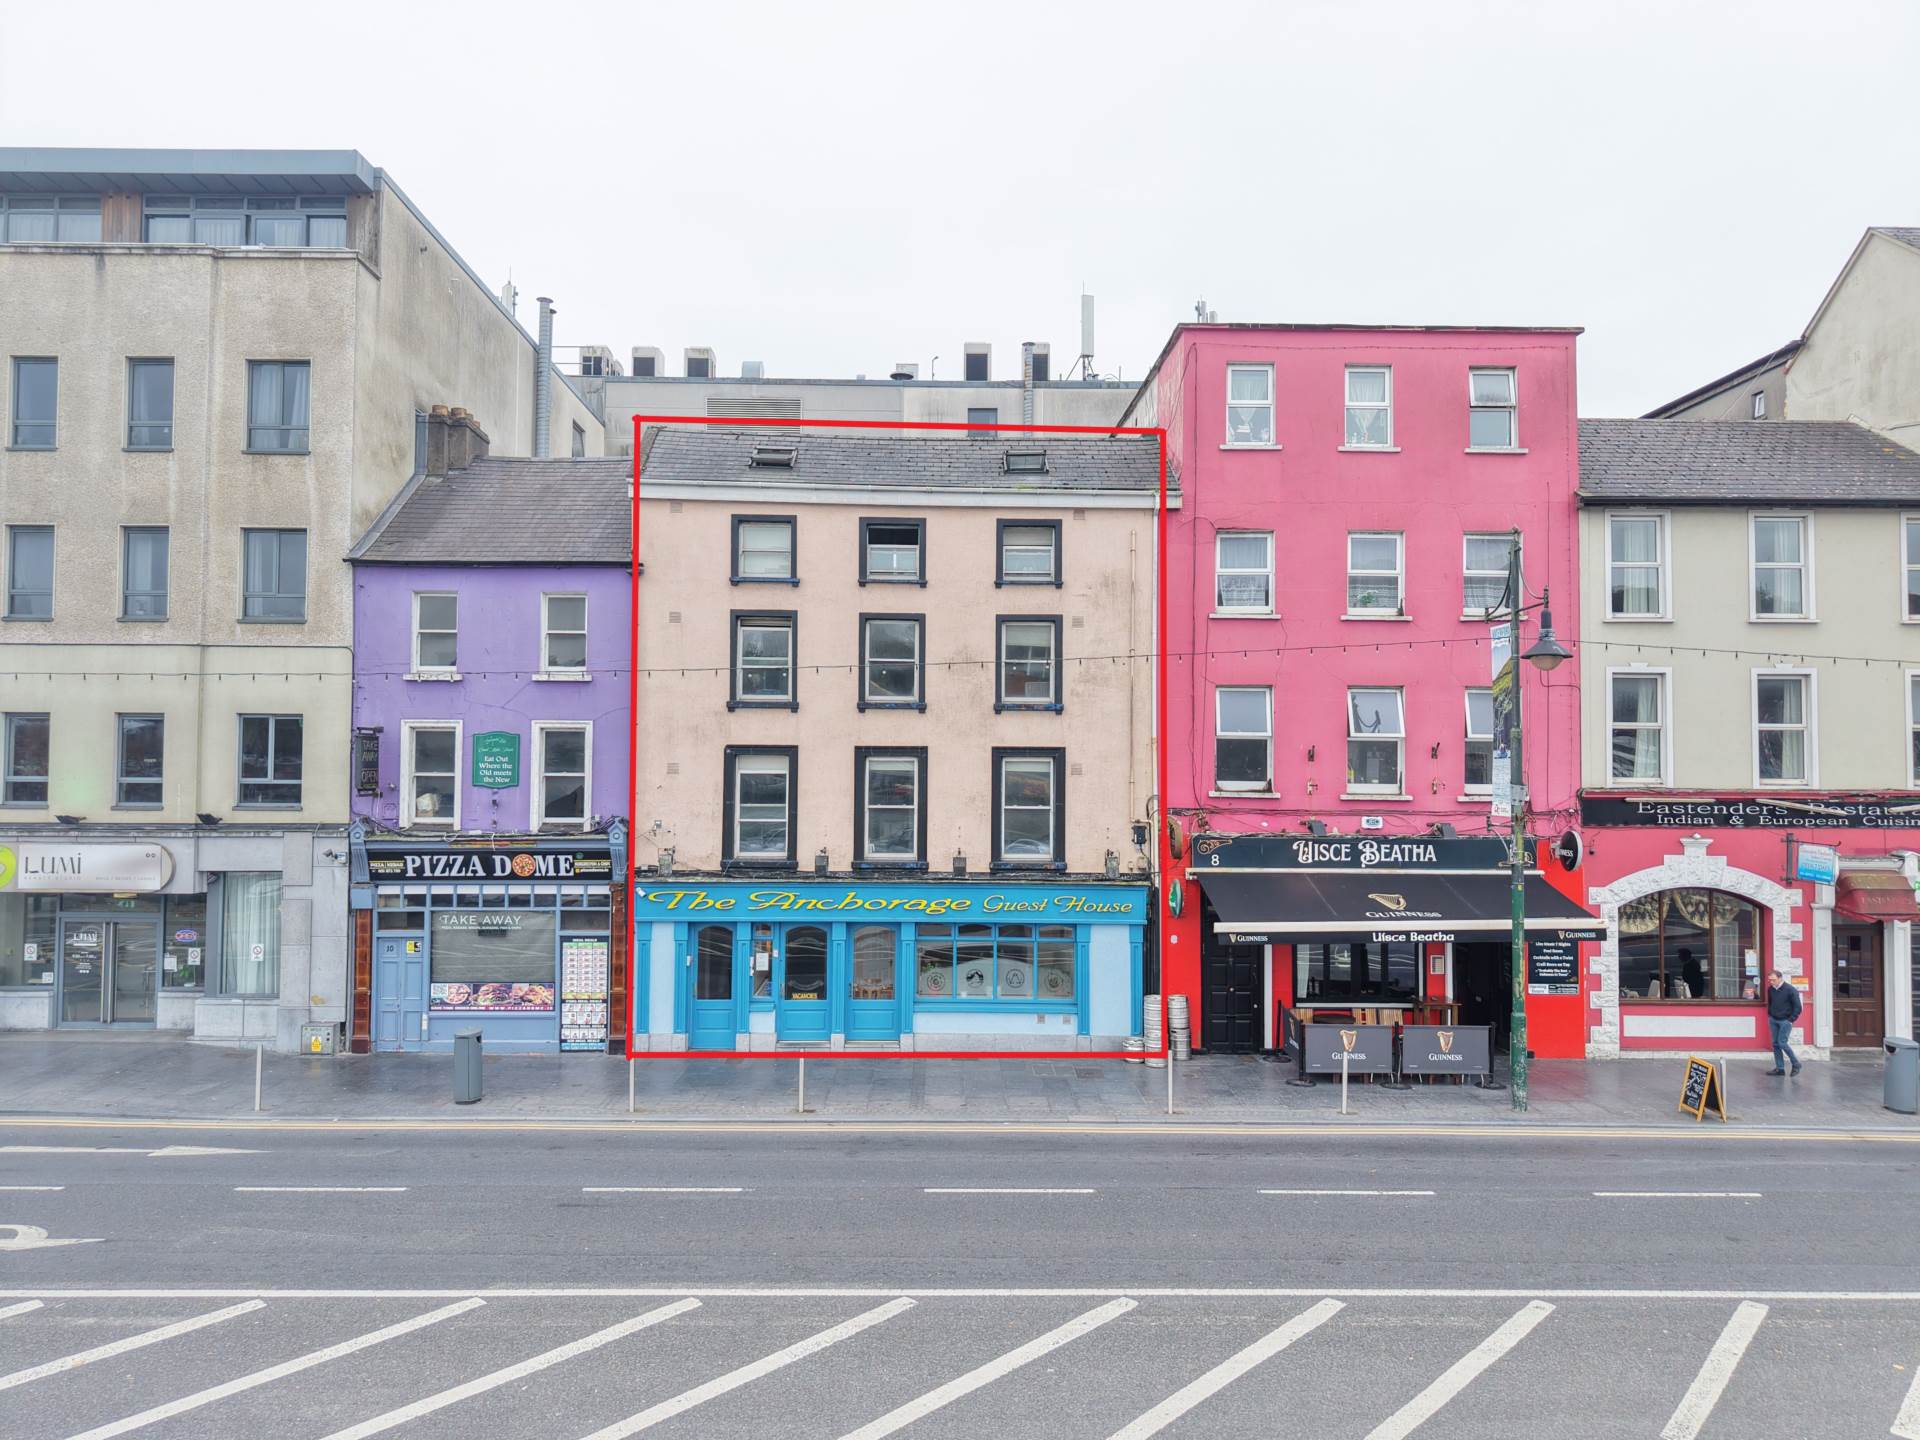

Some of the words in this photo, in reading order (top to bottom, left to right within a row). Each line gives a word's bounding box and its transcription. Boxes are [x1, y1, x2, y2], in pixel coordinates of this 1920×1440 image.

[1637, 801, 1788, 815] Eastenders
[1657, 814, 1714, 825] Indian
[1729, 815, 1744, 825] &
[1759, 815, 1849, 827] European
[404, 854, 486, 877] PIZZA
[1211, 854, 1220, 866] 8
[647, 890, 736, 911] The
[747, 889, 972, 915] Anchorage
[983, 894, 1048, 913] Guest
[1053, 895, 1133, 914] House
[442, 914, 477, 925] TAKE
[482, 914, 522, 925] AWAY
[1410, 931, 1454, 942] Beatha
[1331, 1052, 1367, 1060] GUNNESS
[1428, 1052, 1463, 1061] GUINNESS
